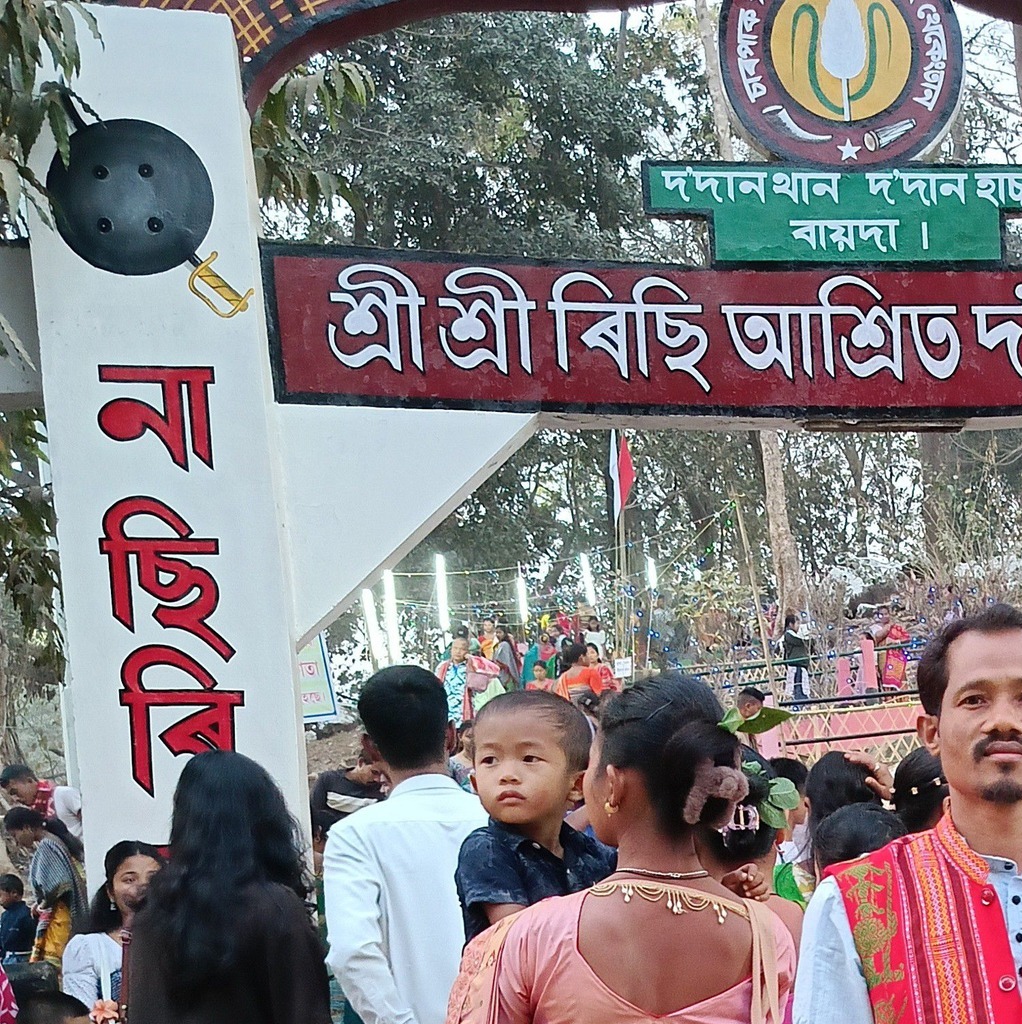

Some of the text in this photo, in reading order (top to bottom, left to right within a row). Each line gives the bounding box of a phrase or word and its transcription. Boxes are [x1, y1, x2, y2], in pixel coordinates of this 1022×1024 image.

[772, 172, 841, 205] থান
[789, 218, 900, 252] বায়দা
[548, 271, 712, 394] ৰিছি
